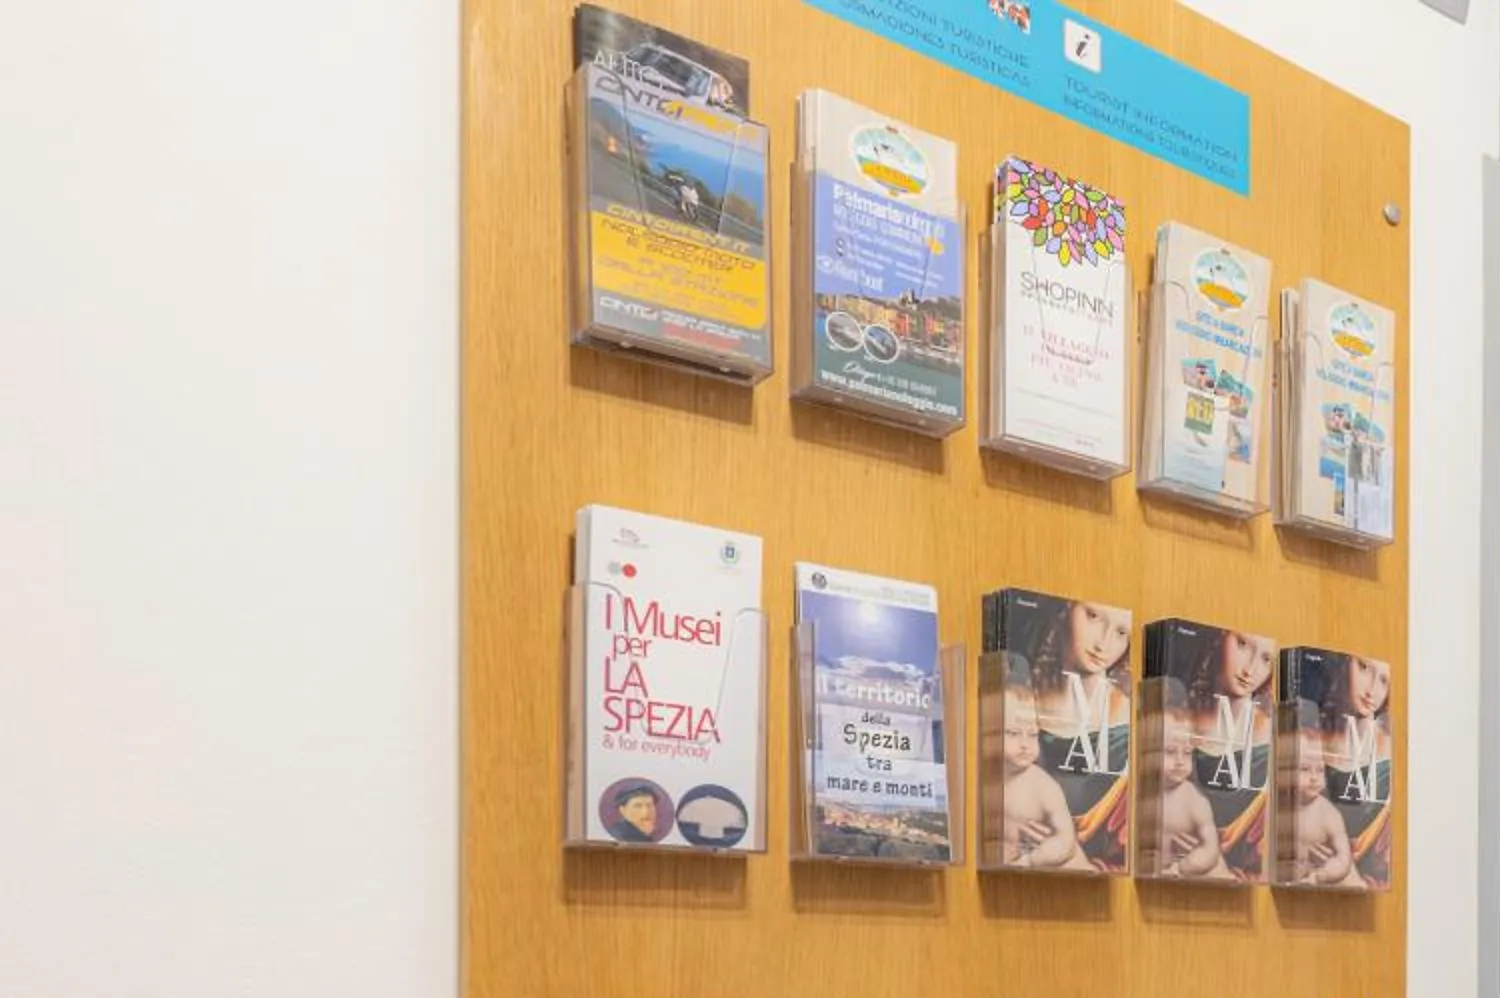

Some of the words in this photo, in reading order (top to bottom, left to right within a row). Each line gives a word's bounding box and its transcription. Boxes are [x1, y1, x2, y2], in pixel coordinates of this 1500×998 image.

[1065, 75, 1129, 114] TOURIST
[1132, 109, 1238, 163] INFORMATION
[1021, 271, 1113, 318] SHOPINN
[605, 593, 613, 630] I
[623, 596, 722, 647] Musei
[612, 633, 652, 659] per
[604, 657, 648, 698] LA
[603, 696, 721, 743] SPEZIA
[861, 711, 891, 726] della
[618, 737, 637, 751] for
[641, 739, 711, 761] everybody
[843, 723, 911, 752] Spezia
[866, 755, 892, 771] tra
[827, 775, 868, 793] mare
[873, 780, 881, 794] e
[886, 777, 933, 798] monti
